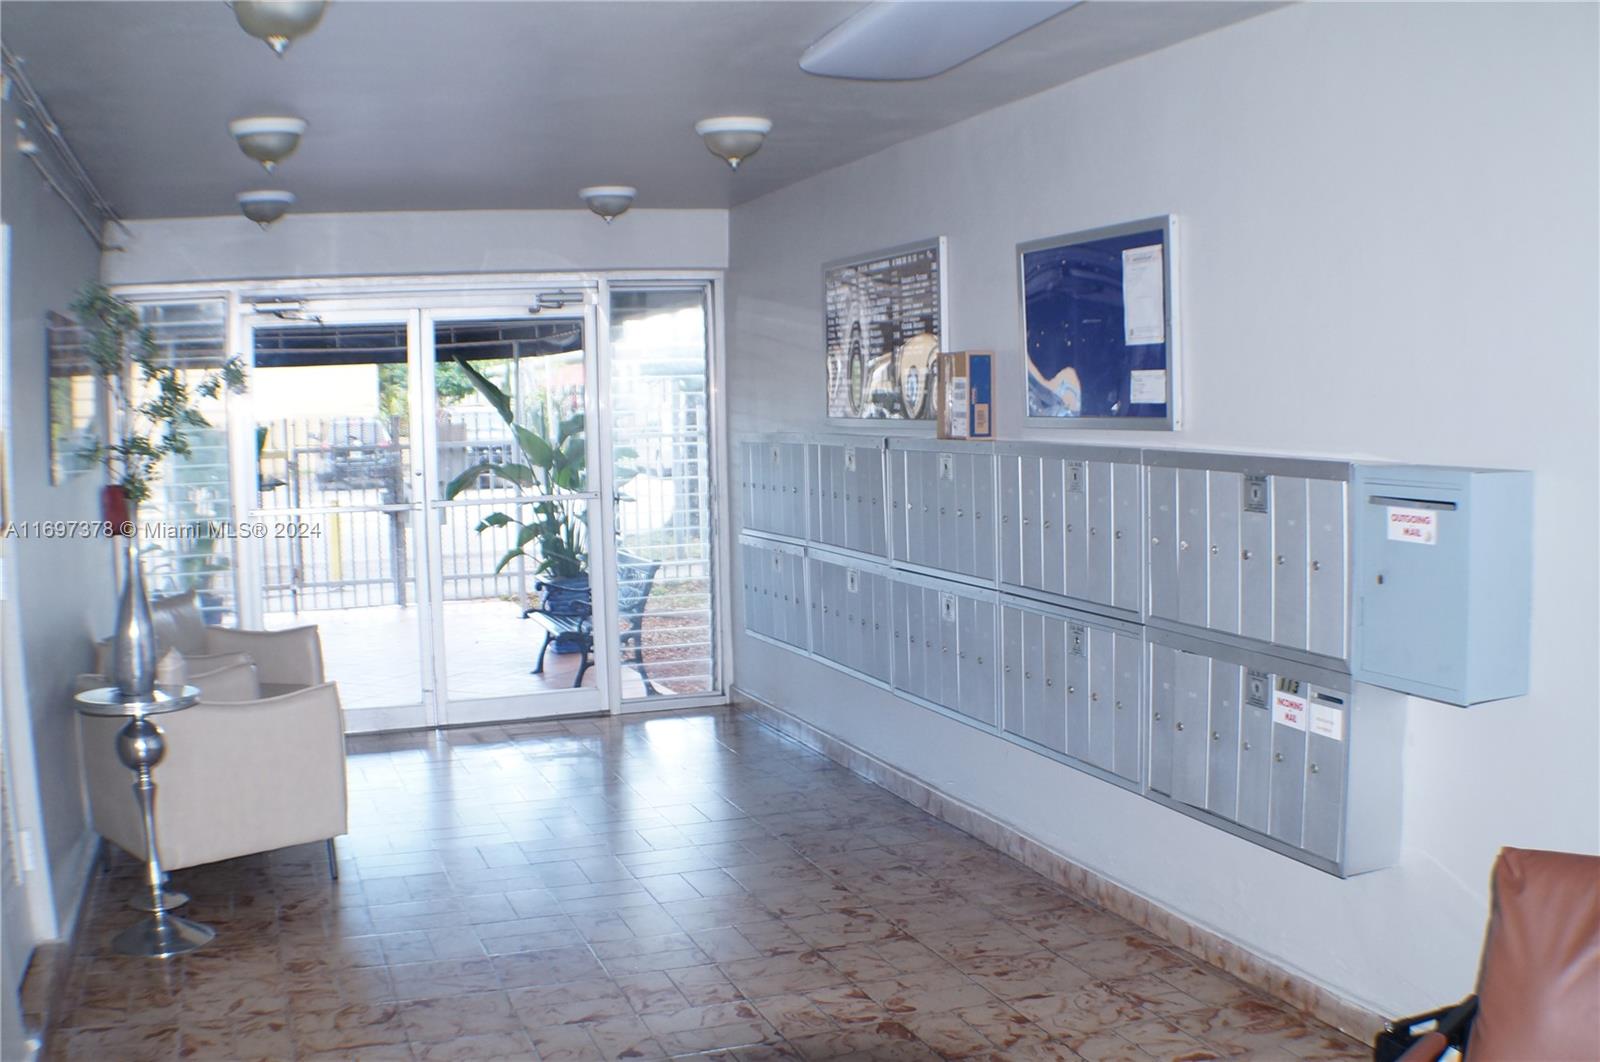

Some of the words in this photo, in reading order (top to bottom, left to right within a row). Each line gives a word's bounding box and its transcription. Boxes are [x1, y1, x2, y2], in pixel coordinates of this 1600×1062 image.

[1391, 513, 1431, 525] OUTGOING
[1402, 527, 1422, 537] MAIL
[1276, 696, 1304, 712] INCOMING
